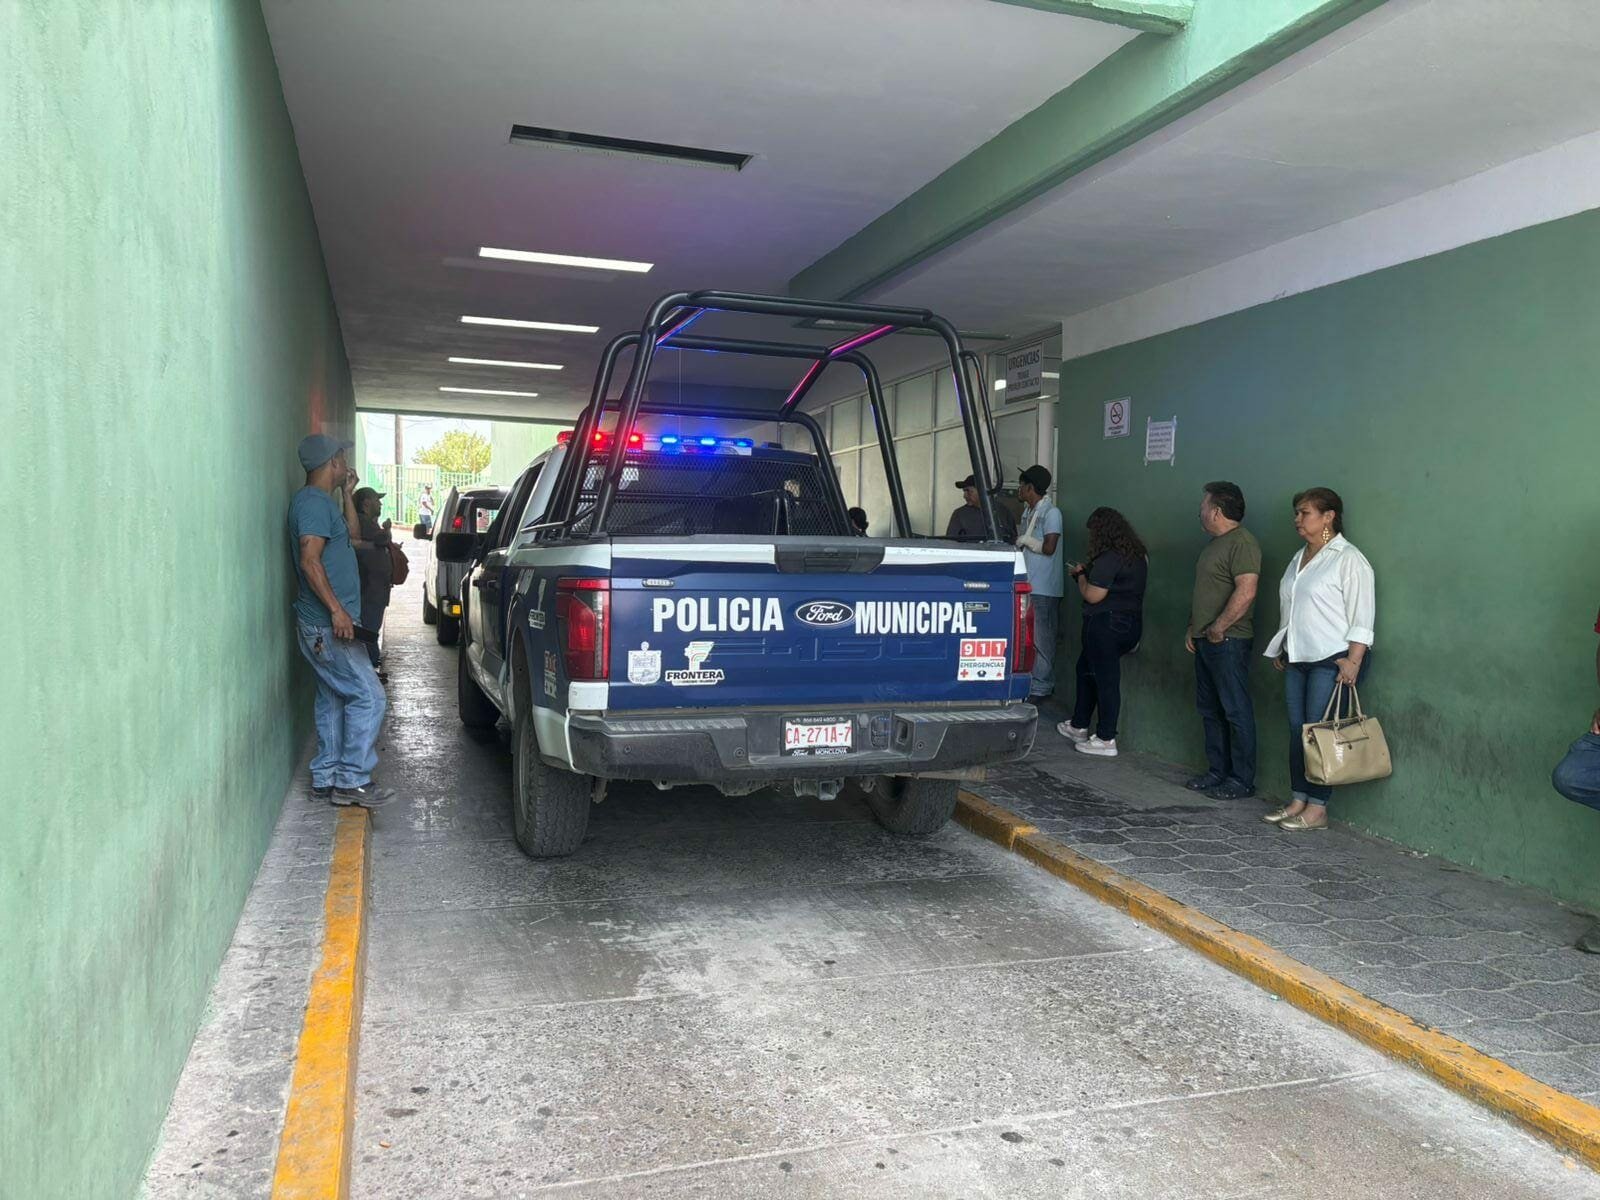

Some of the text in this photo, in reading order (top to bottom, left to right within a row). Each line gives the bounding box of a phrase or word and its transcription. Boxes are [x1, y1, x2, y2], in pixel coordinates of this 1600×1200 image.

[1008, 351, 1040, 370] URGENCIAS
[653, 597, 784, 632] POLICIA
[805, 604, 843, 622] Ford
[855, 601, 977, 634] MUNICIPAL
[964, 643, 1002, 656] 911
[666, 671, 723, 680] FRONTERA
[785, 727, 852, 744] CA-271A-7
[815, 748, 847, 756] MONCLOVA
